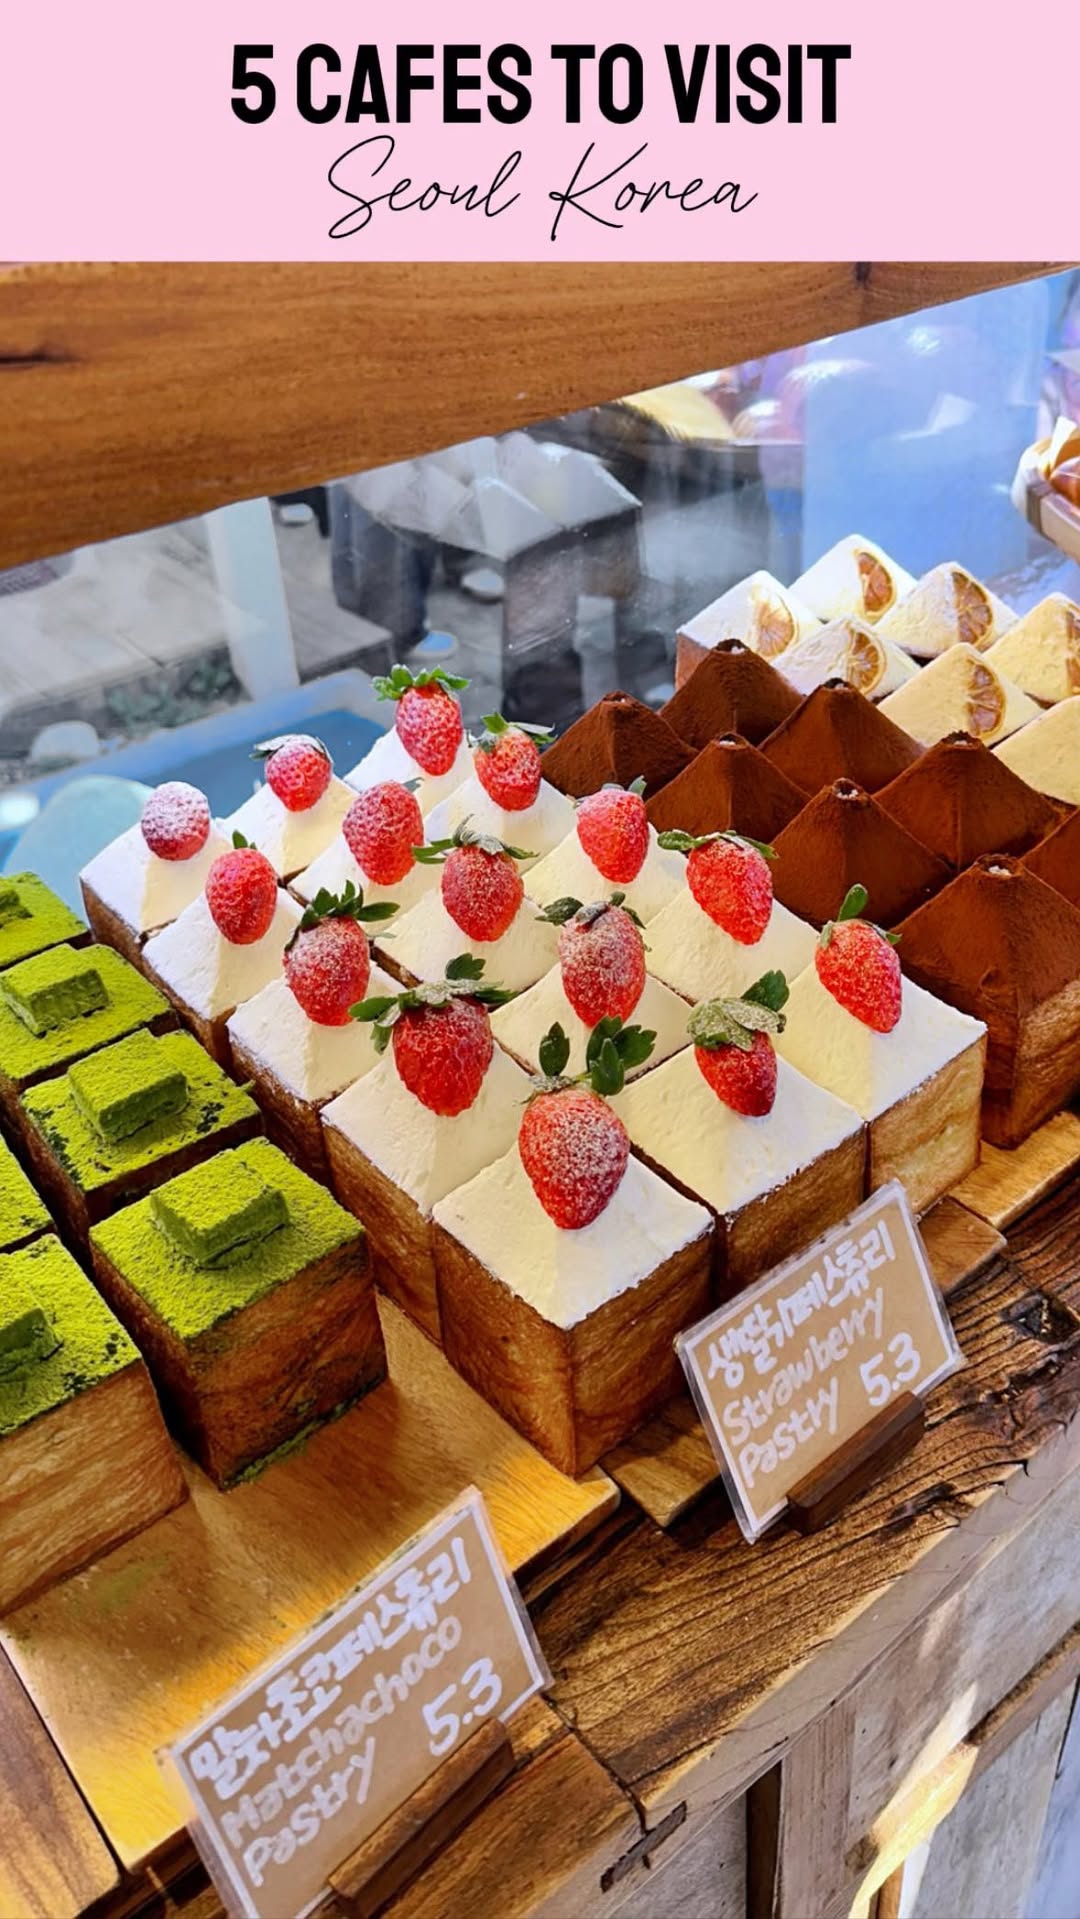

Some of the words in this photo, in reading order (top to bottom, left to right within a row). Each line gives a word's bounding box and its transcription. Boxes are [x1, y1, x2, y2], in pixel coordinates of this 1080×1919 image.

[723, 1288, 883, 1446] Strawberry
[739, 1378, 839, 1488] Pastry
[859, 1332, 921, 1406] 5.3
[221, 1616, 462, 1848] Matchachoco
[243, 1736, 375, 1888] Pastry
[422, 1657, 502, 1757] 5.3
